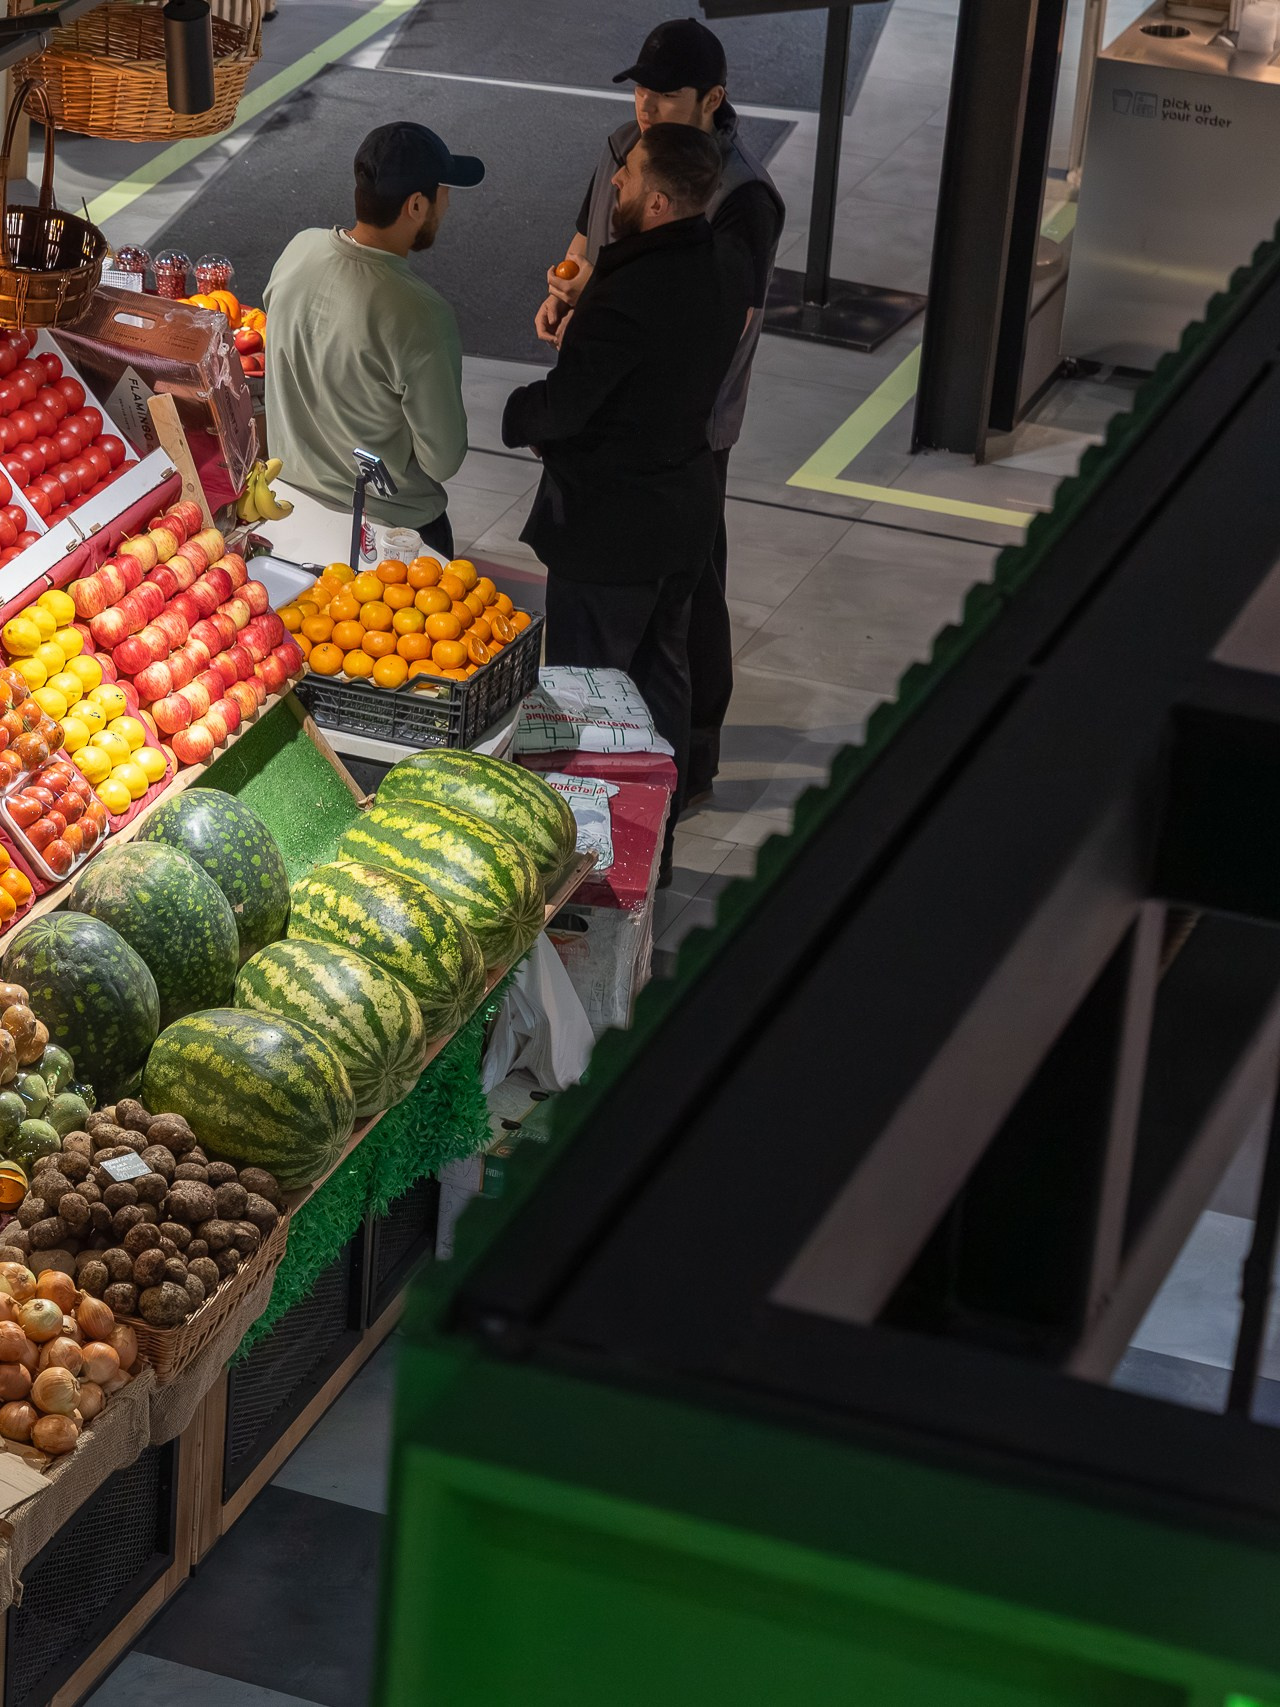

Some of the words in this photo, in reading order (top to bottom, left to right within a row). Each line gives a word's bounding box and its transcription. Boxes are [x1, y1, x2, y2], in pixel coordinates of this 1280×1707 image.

[1162, 98, 1191, 111] pick
[1195, 103, 1212, 114] up
[1162, 110, 1192, 121] your
[1195, 115, 1232, 128] order
[128, 377, 154, 441] FLAMINGO
